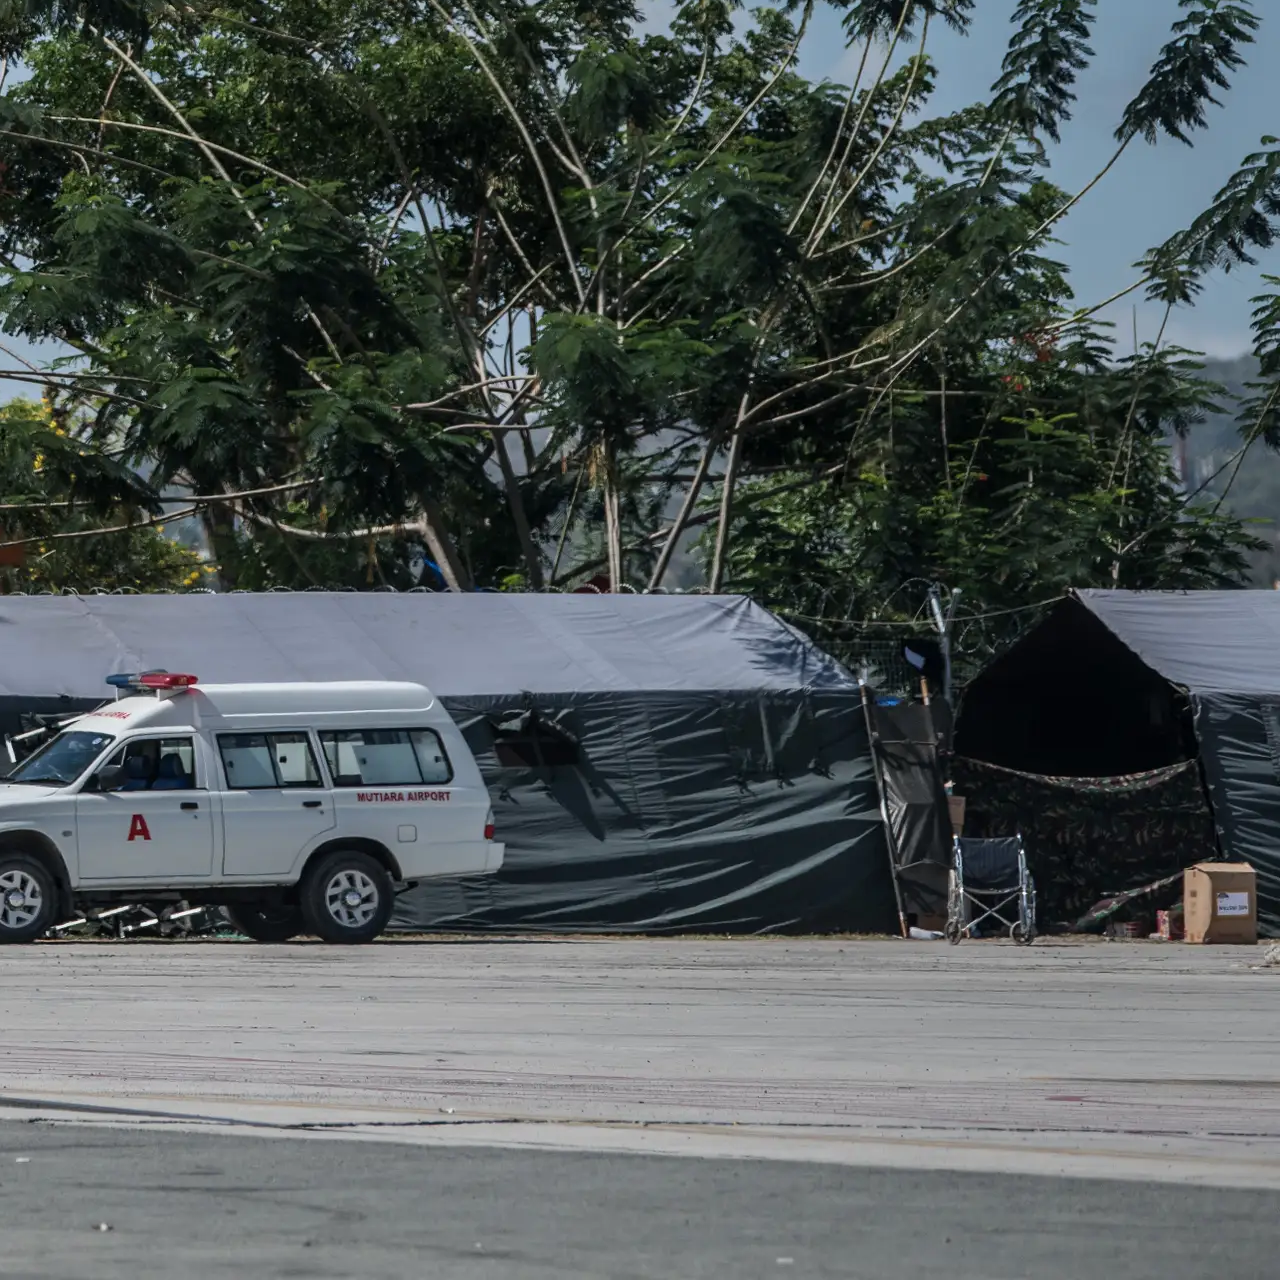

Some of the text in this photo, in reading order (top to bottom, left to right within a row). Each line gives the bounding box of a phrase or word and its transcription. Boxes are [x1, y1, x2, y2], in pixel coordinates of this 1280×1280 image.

[356, 791, 451, 802] MUTIARA AIRPORT
[128, 814, 152, 841] A
